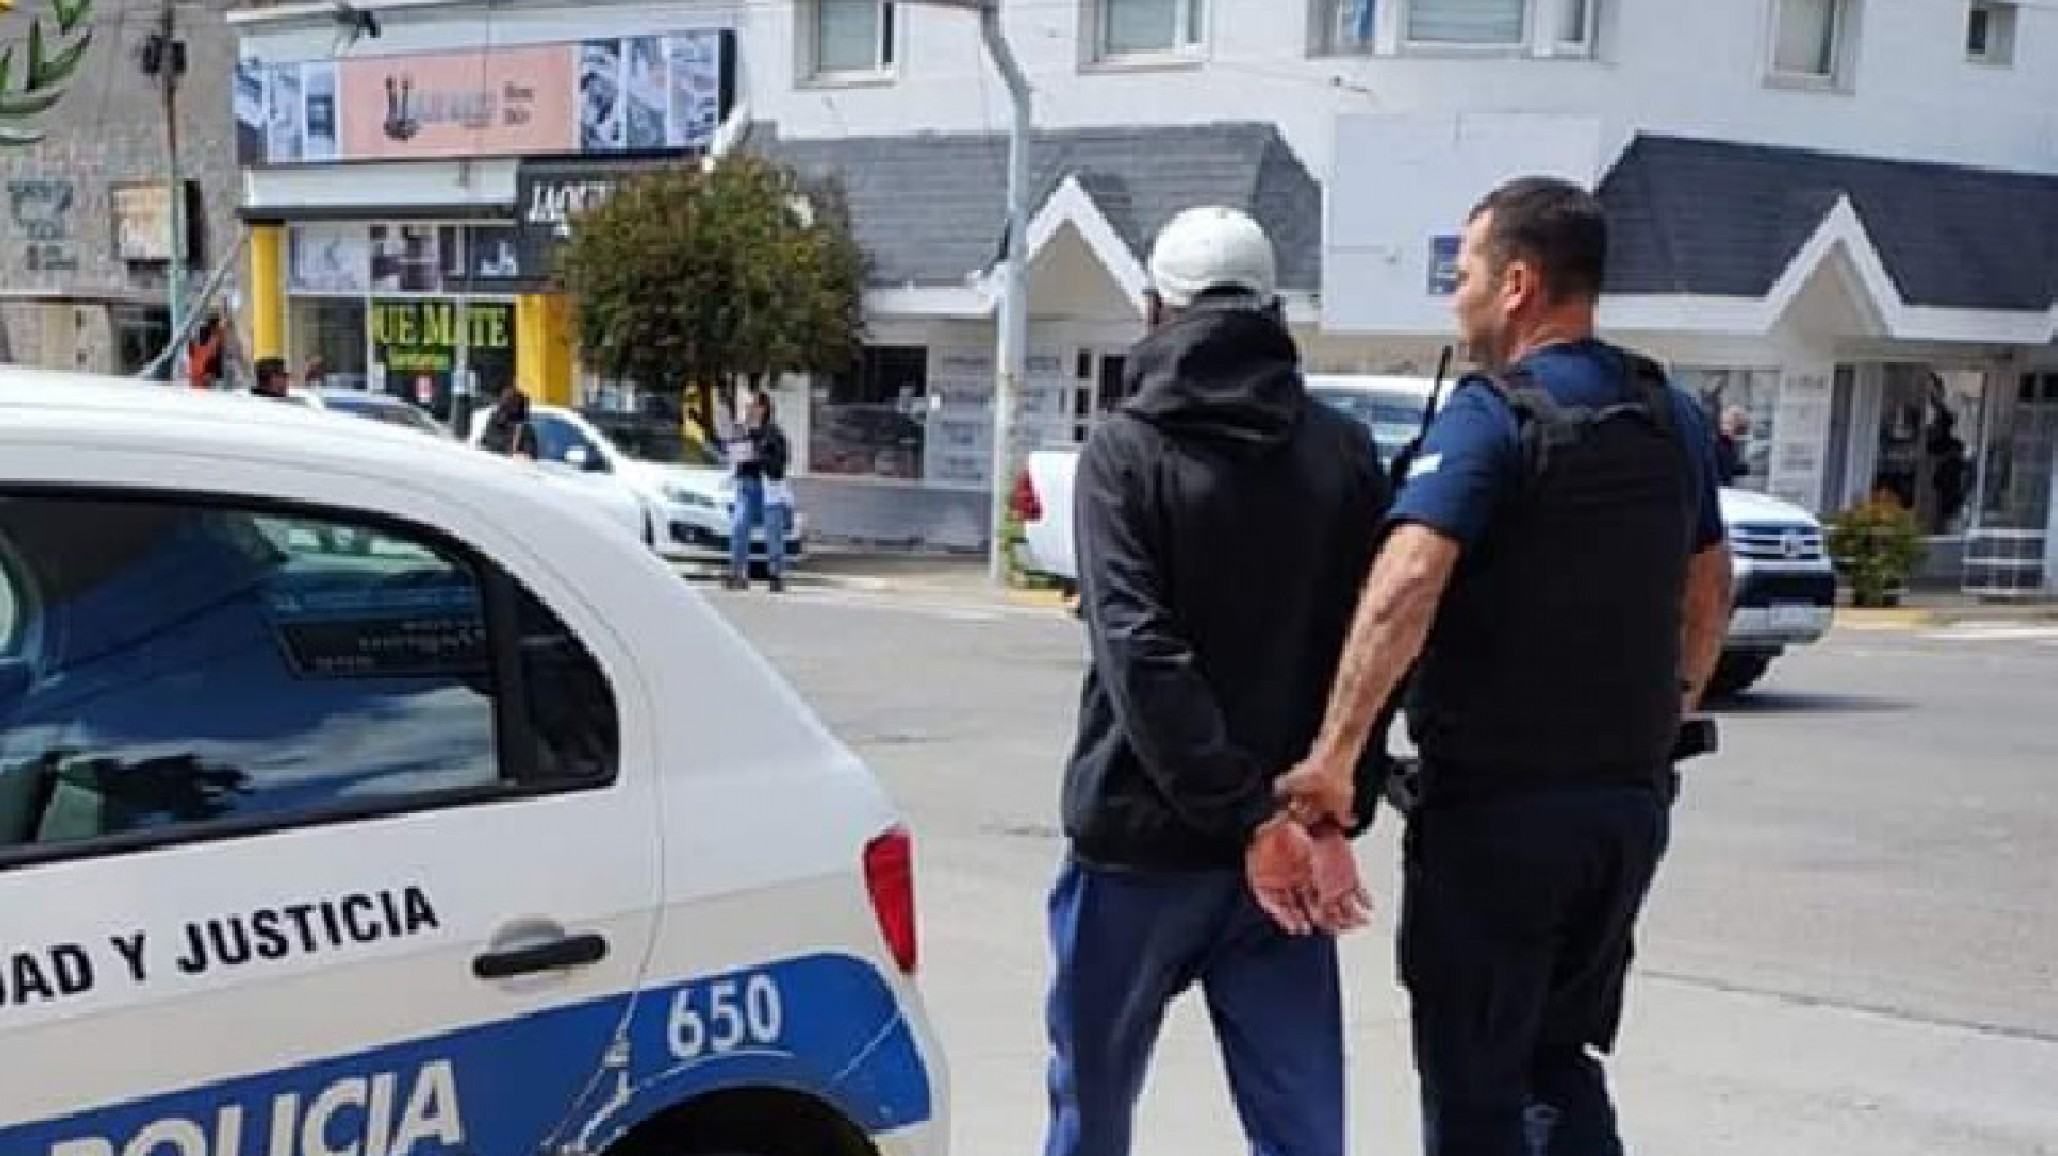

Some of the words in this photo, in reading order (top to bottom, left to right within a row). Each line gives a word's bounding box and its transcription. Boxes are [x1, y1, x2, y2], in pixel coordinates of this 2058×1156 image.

[0, 942, 96, 1006] AD
[111, 931, 146, 981] Y
[175, 885, 439, 975] JUSTICIA
[668, 974, 781, 1057] 650
[48, 1057, 464, 1156] LICIA
